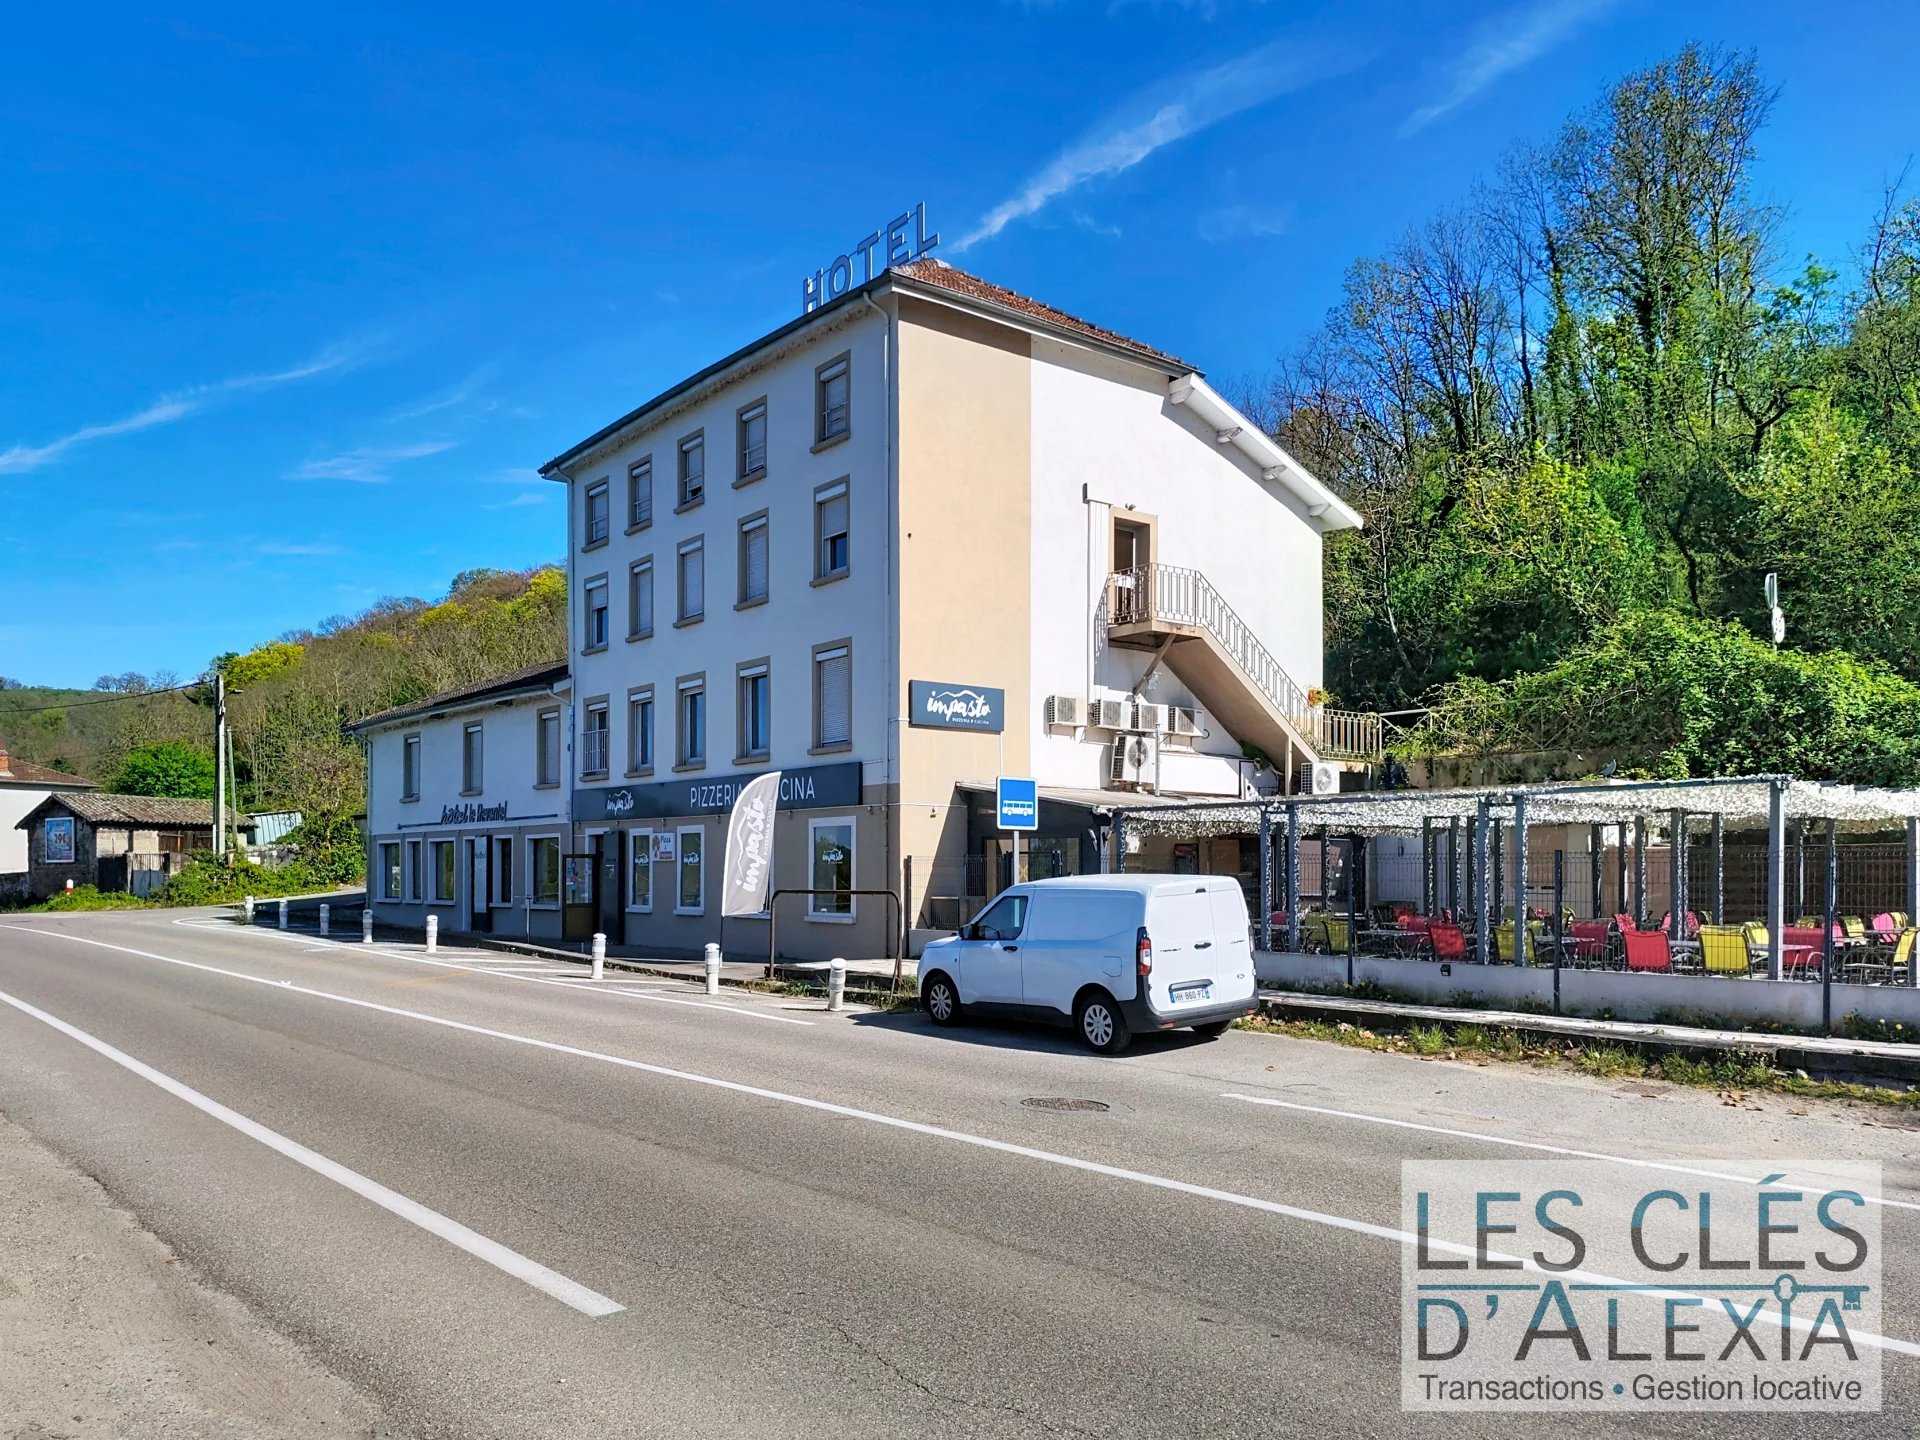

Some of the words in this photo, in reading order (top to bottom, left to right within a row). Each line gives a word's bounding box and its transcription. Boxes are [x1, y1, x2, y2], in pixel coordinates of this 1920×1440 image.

[803, 201, 940, 313] HOTEL
[927, 690, 991, 721] impasto
[606, 790, 634, 816] impasto
[780, 776, 815, 801] CINA
[736, 796, 767, 892] impasto
